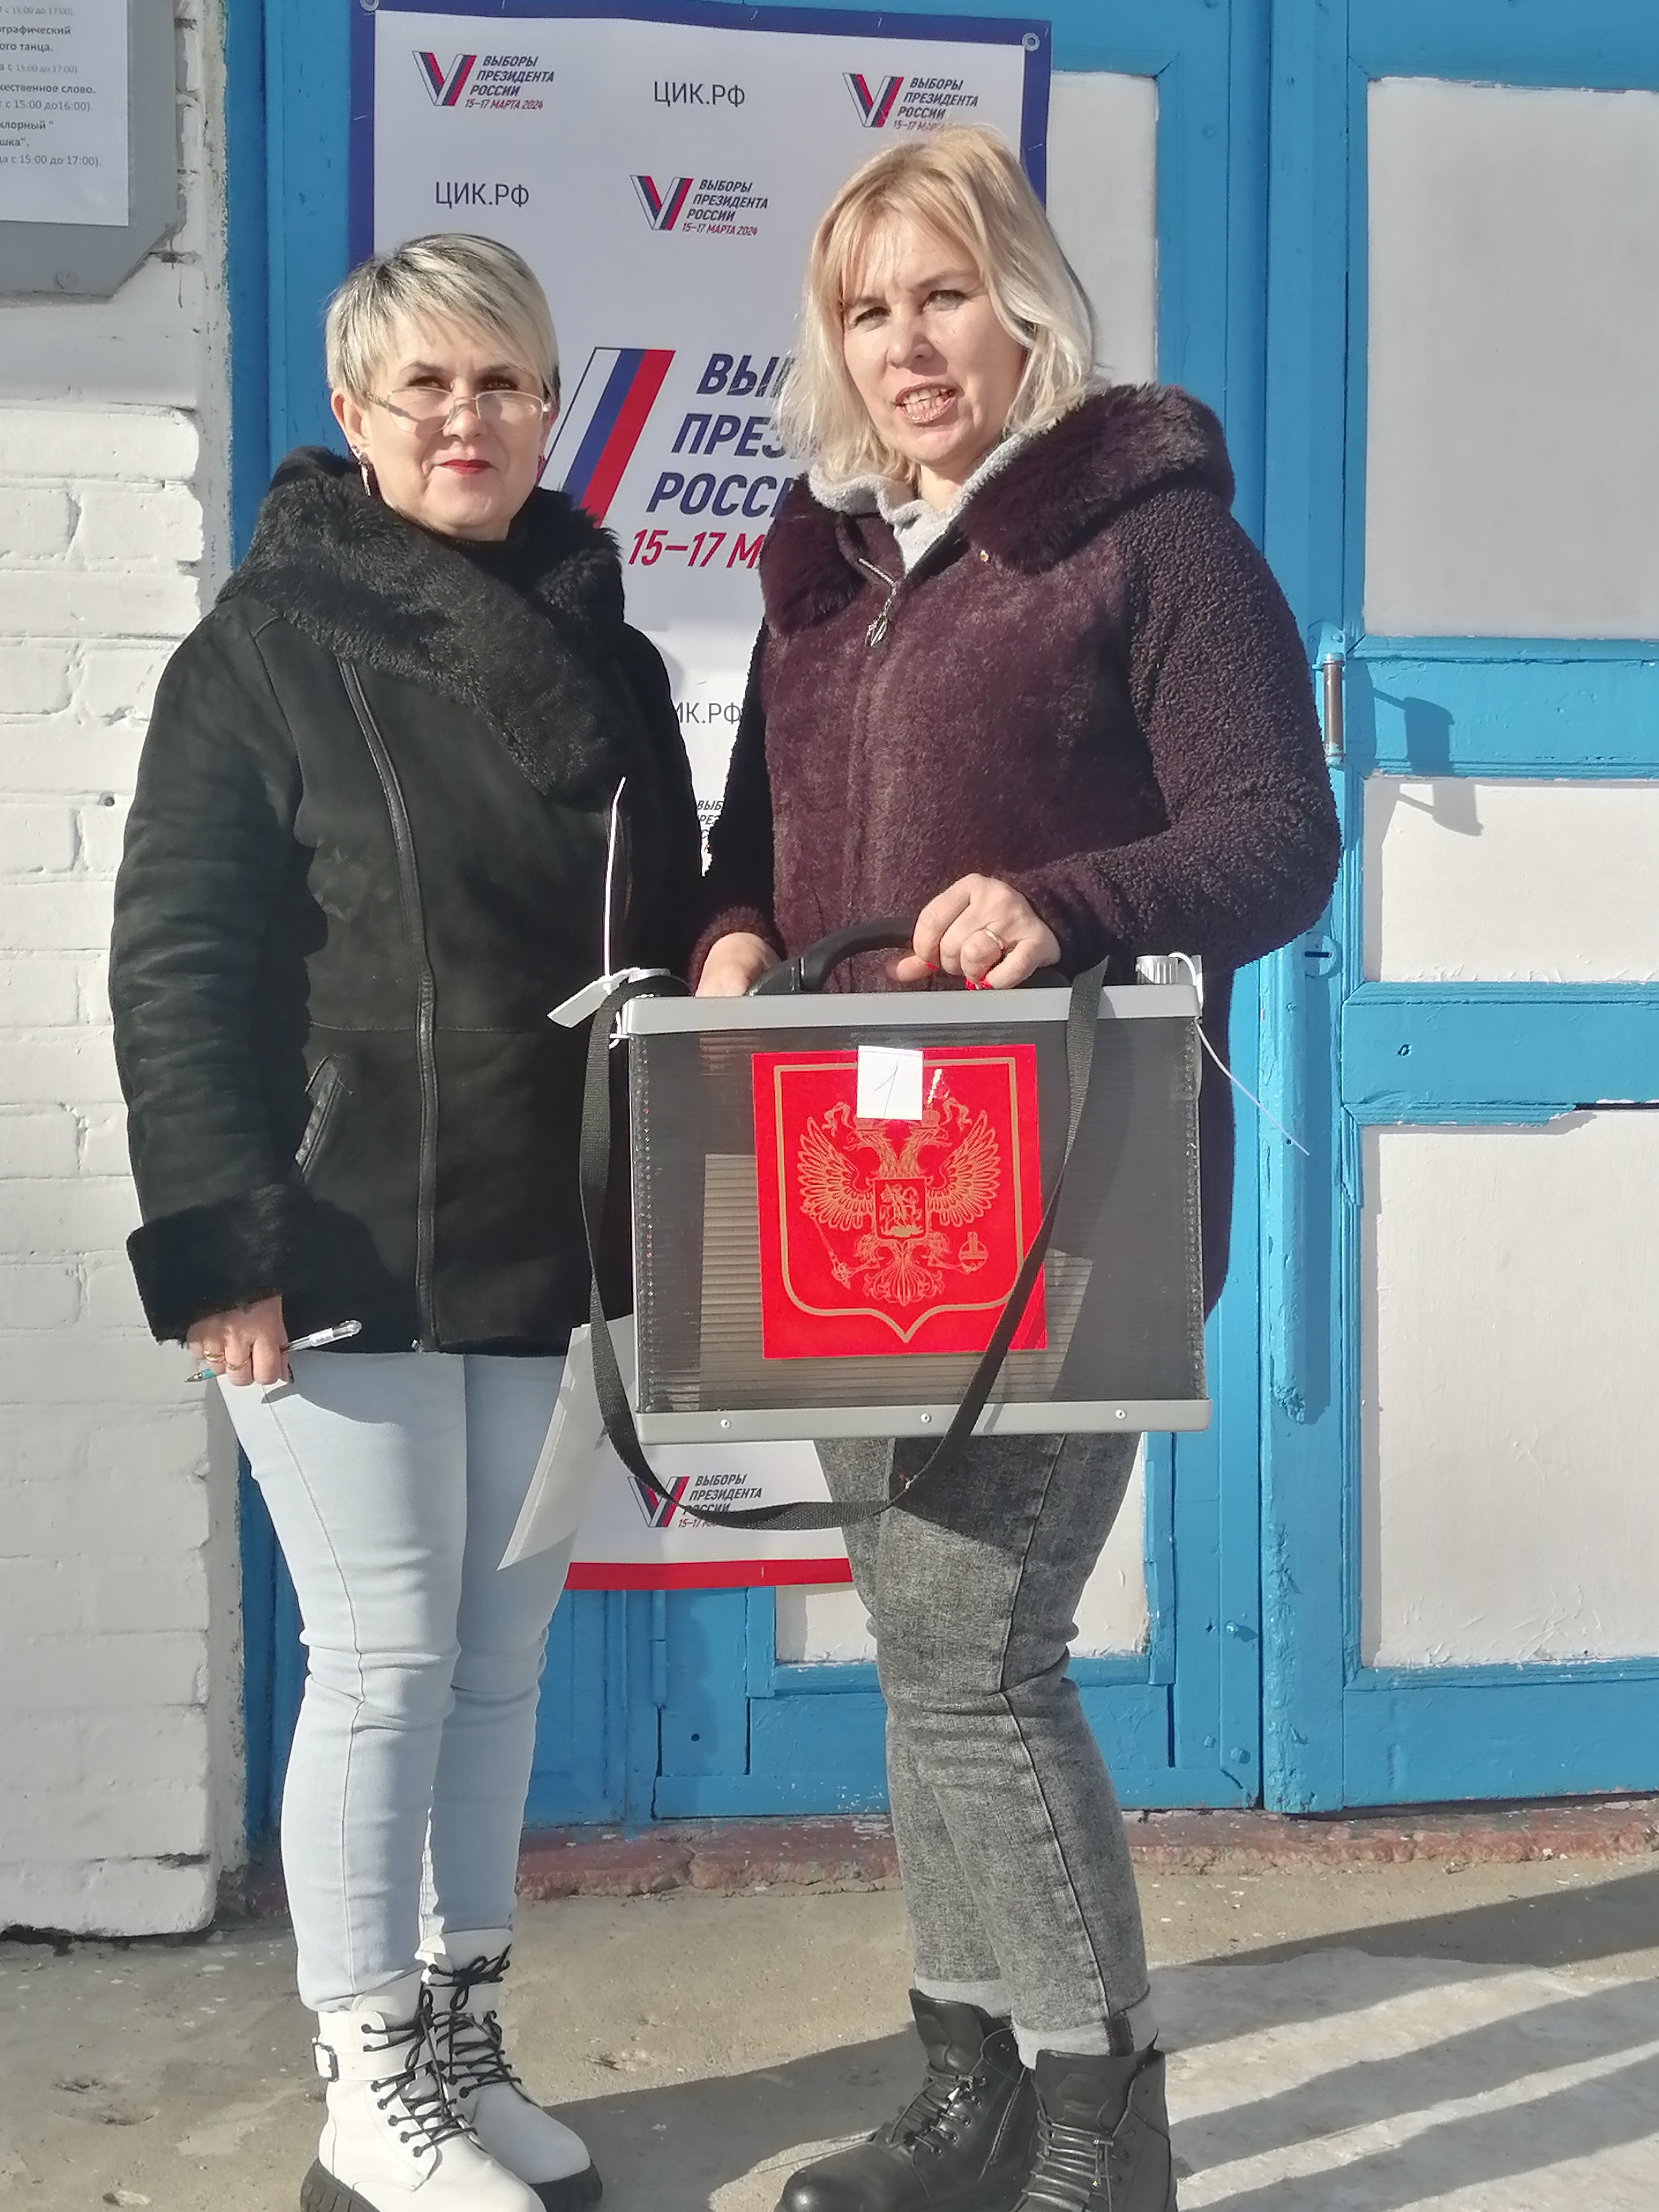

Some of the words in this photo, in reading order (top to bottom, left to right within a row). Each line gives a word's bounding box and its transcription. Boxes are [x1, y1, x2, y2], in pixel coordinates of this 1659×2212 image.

[19, 44, 53, 53] танца.
[483, 56, 539, 67] ВЫБОРЫ
[477, 70, 554, 82] ПРЕЗИДЕНТА
[470, 85, 520, 96] РОССИИ
[910, 78, 963, 91] ВЫБОРЫ
[655, 81, 745, 107] ЦИК.РФ
[903, 92, 978, 107] ПРЕЗИДЕНТА
[490, 99, 520, 109] МАРТА
[522, 100, 543, 110] 2024
[897, 106, 946, 120] РОССИИ
[699, 179, 752, 192] ВЫБОРЫ
[436, 181, 529, 209] ЦИК.РФ
[692, 194, 768, 209] ПРЕЗИДЕНТА
[686, 209, 736, 222] РОССИИ
[707, 224, 735, 234] МАРТА
[736, 226, 757, 236] 2024
[695, 1474, 747, 1487] ВЫБОРЫ
[689, 1488, 762, 1501] ПРЕЗИДЕНТА
